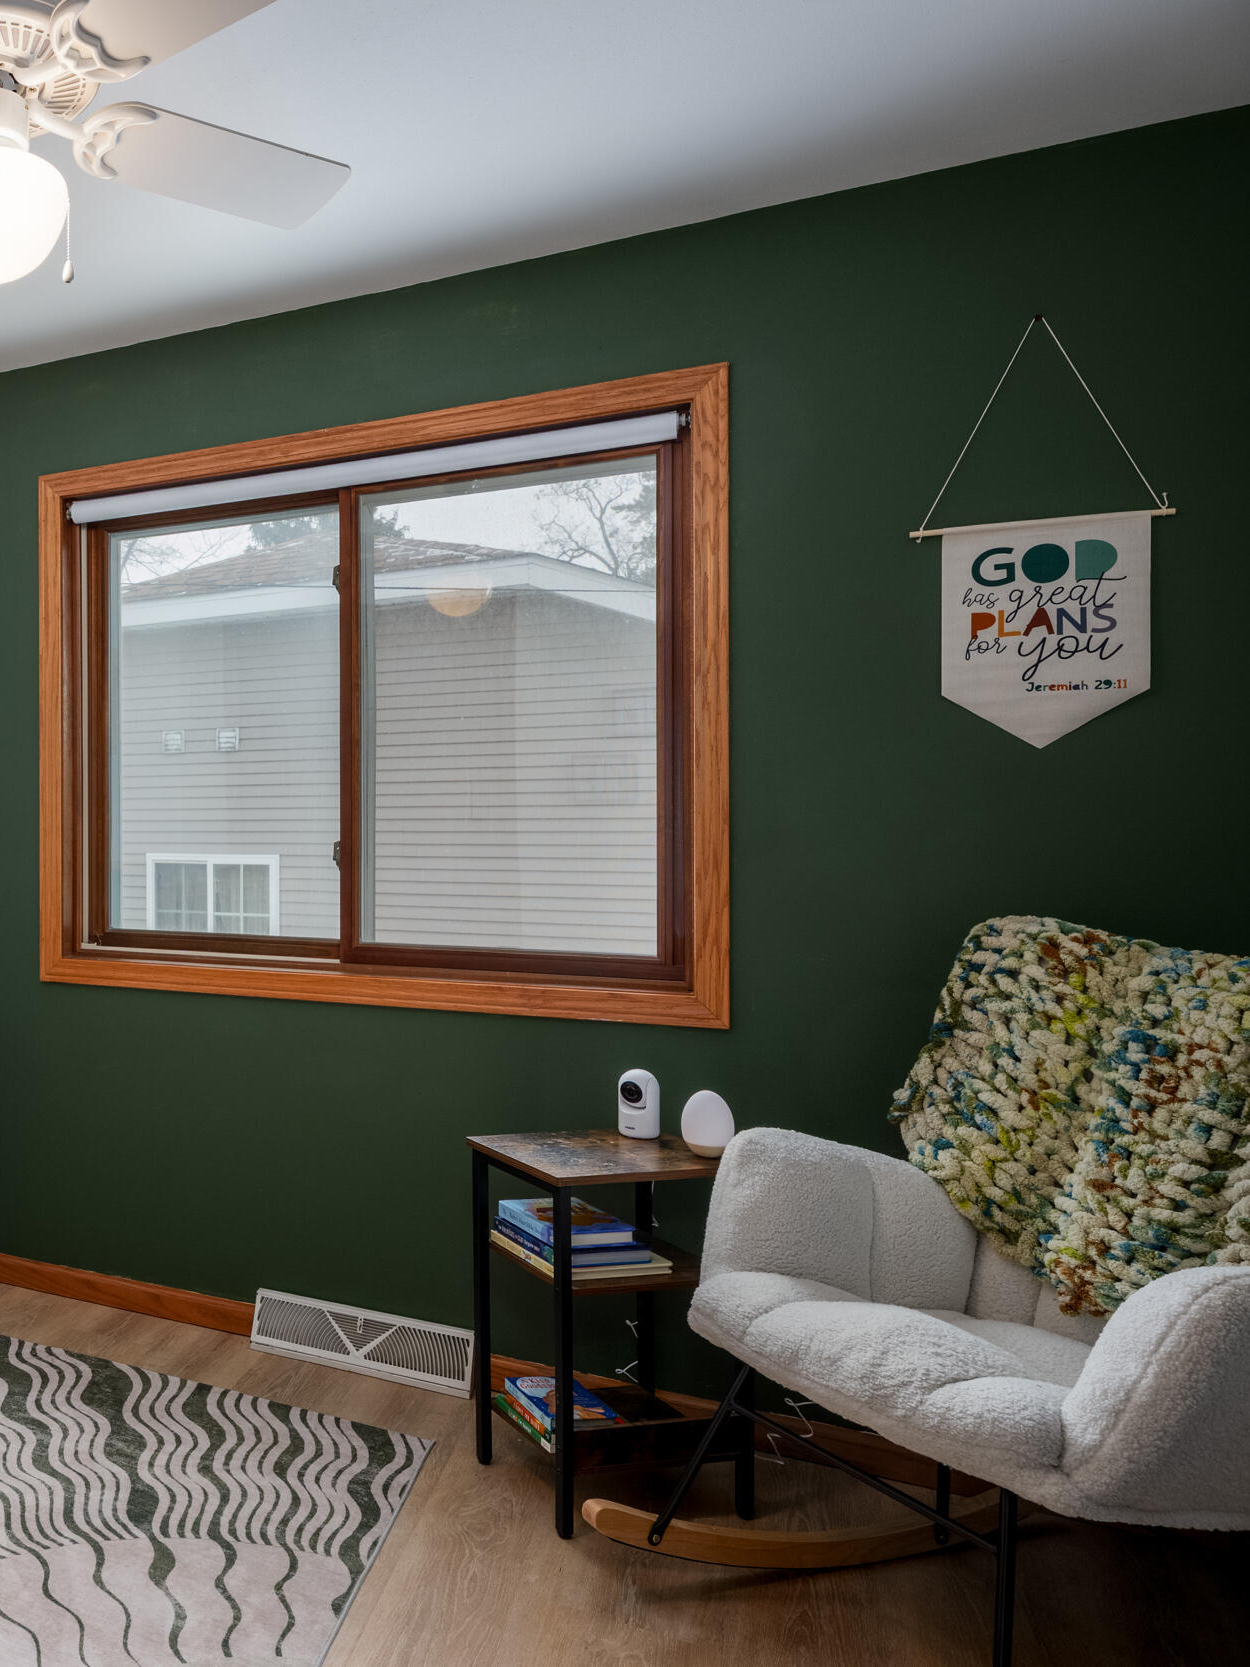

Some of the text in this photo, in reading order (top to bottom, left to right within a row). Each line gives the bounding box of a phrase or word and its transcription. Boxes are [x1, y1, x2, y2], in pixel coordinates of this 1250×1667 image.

[971, 539, 1118, 587] GOD
[962, 571, 1127, 623] has great
[970, 603, 1118, 639] PLANS
[965, 635, 1124, 681] for you
[1025, 678, 1128, 692] Jeremiah 29:11
